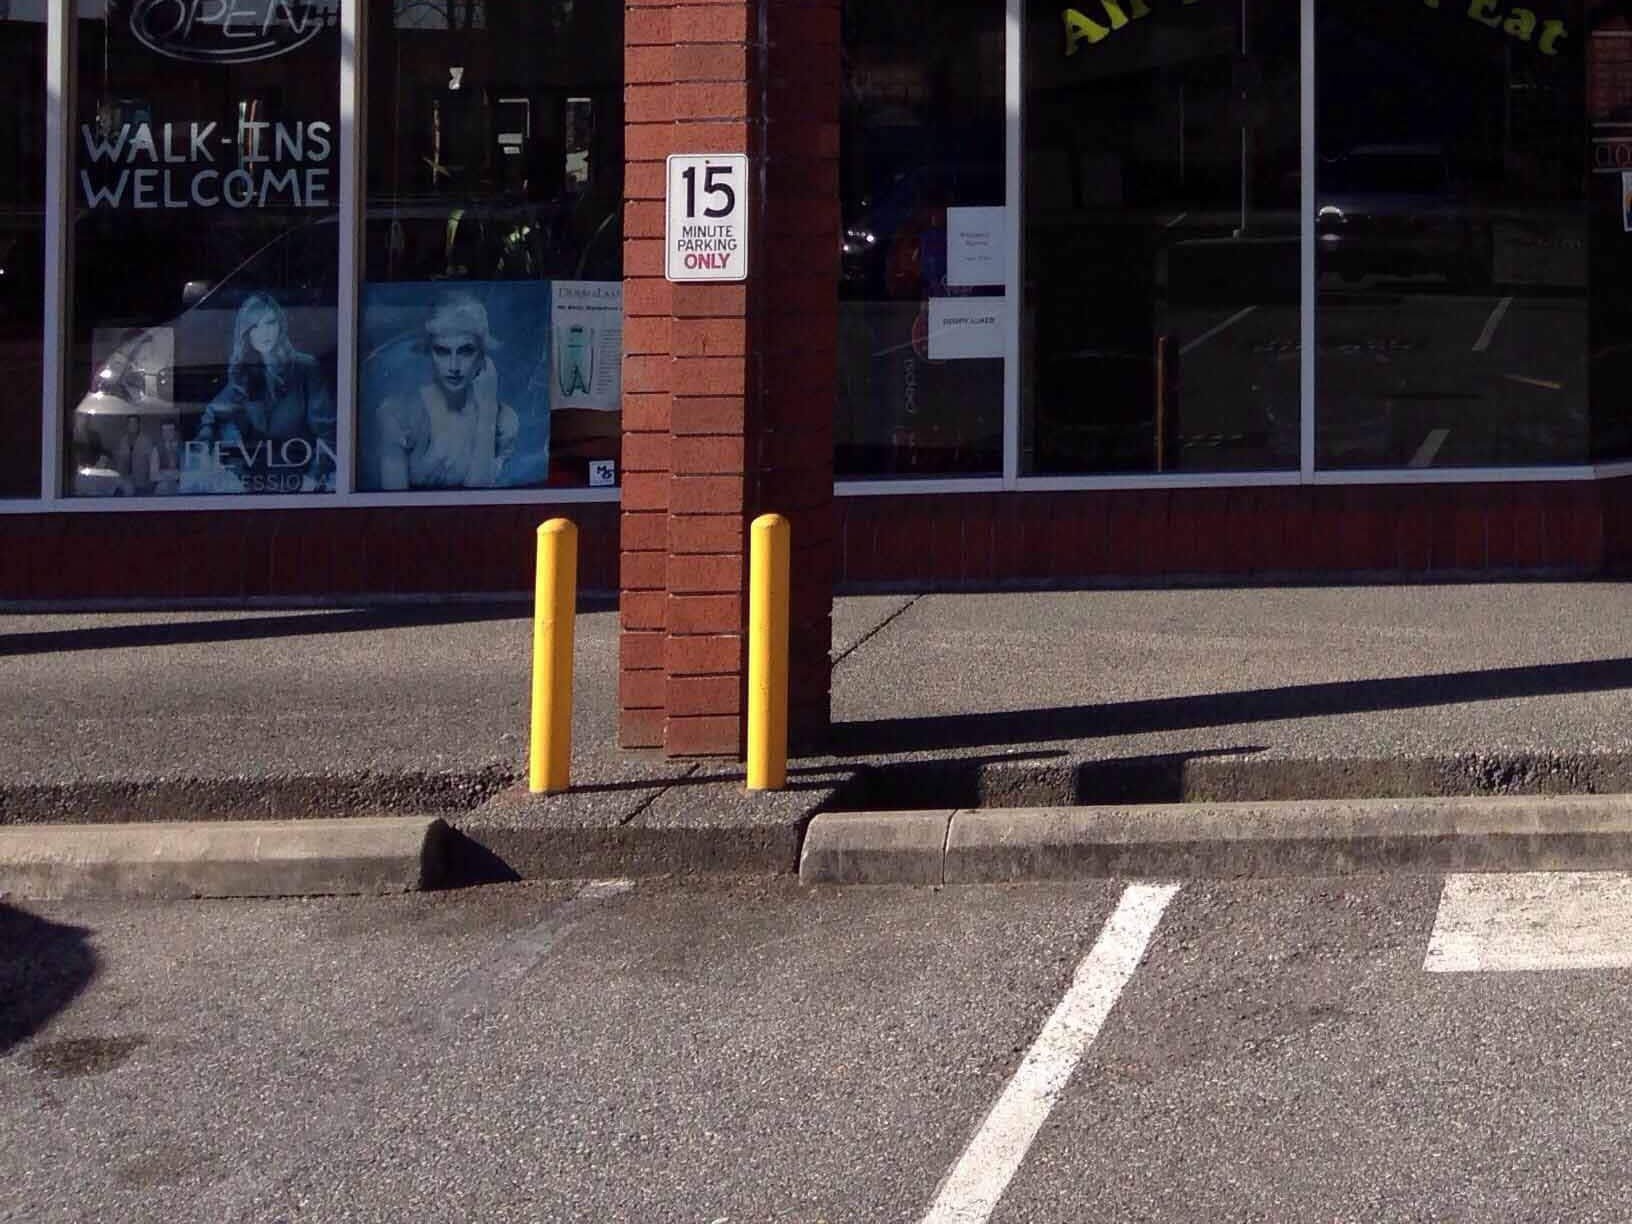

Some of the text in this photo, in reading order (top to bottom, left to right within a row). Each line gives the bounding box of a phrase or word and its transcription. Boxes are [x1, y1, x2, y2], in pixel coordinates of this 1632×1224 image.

[80, 121, 332, 164] WALK-INS
[80, 168, 331, 209] WELCOME
[682, 166, 736, 218] 15
[677, 238, 738, 252] PARKING
[682, 225, 735, 238] MINUTE
[684, 253, 731, 269] ONLY
[184, 437, 338, 469] REVLON
